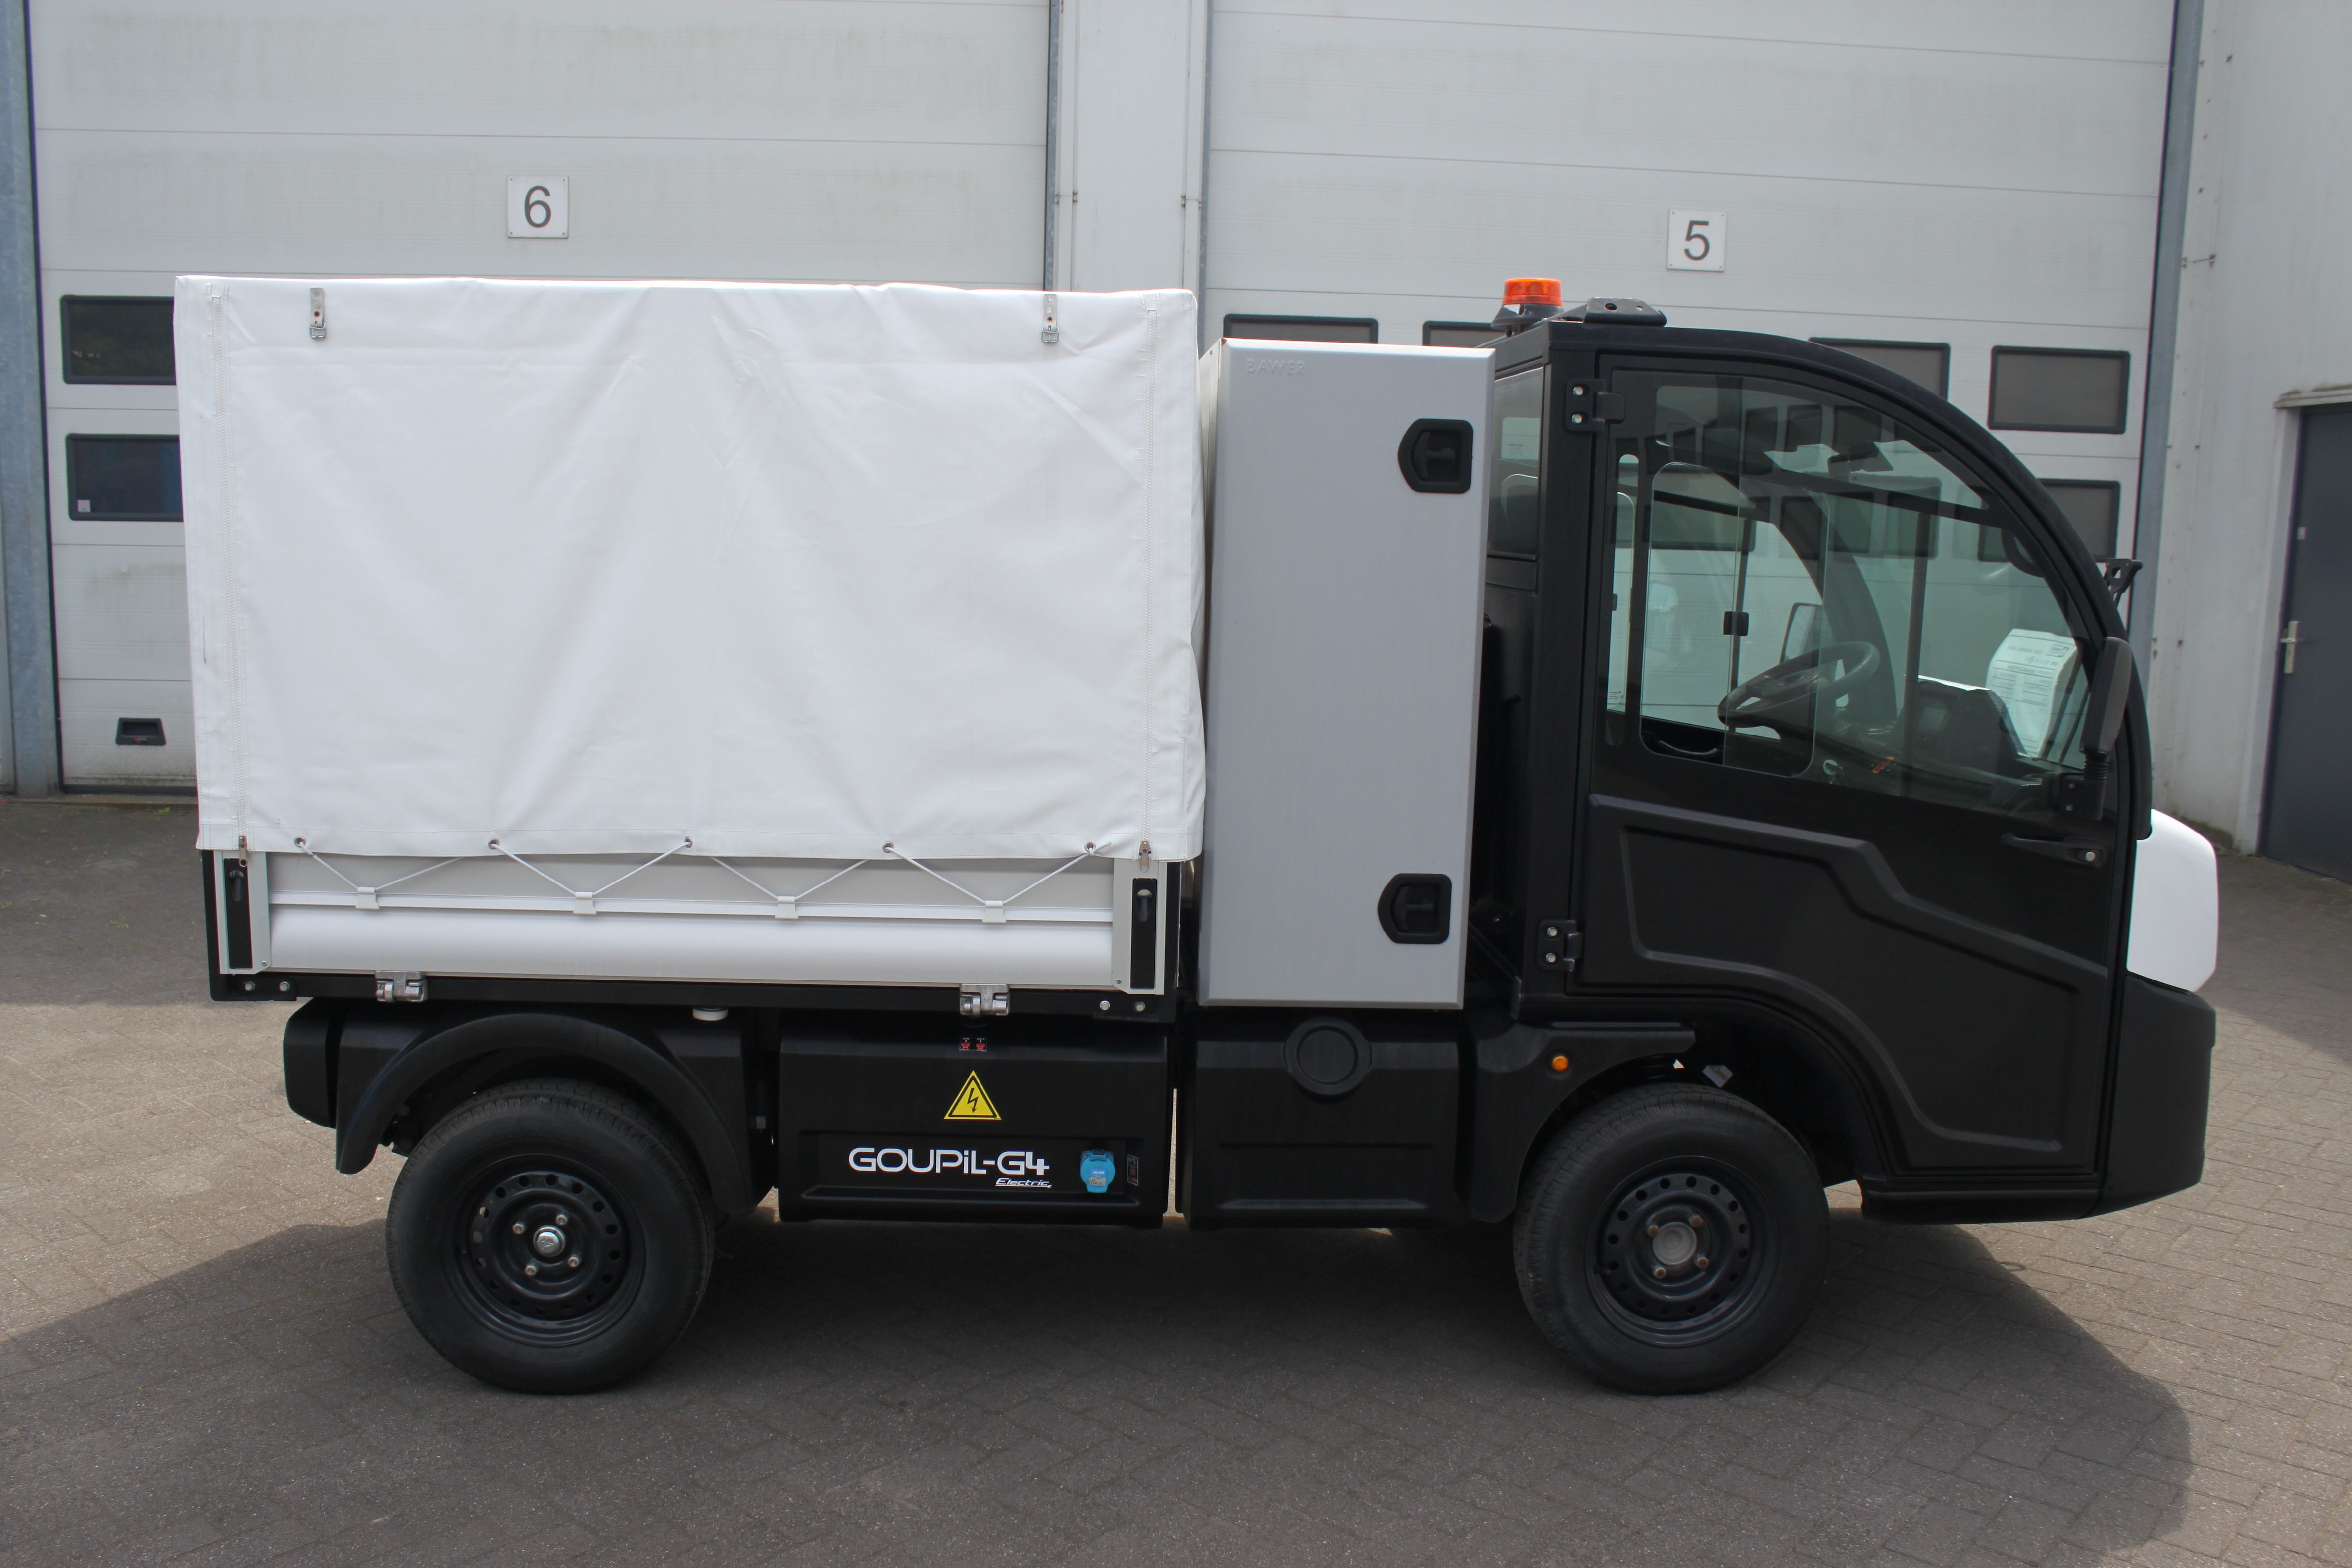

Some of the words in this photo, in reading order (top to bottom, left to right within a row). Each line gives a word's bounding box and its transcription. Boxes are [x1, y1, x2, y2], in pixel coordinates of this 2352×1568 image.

[524, 185, 551, 228] 6
[1684, 220, 1710, 261] 5
[1246, 358, 1306, 376] BAWER
[995, 1177, 1050, 1186] Electric
